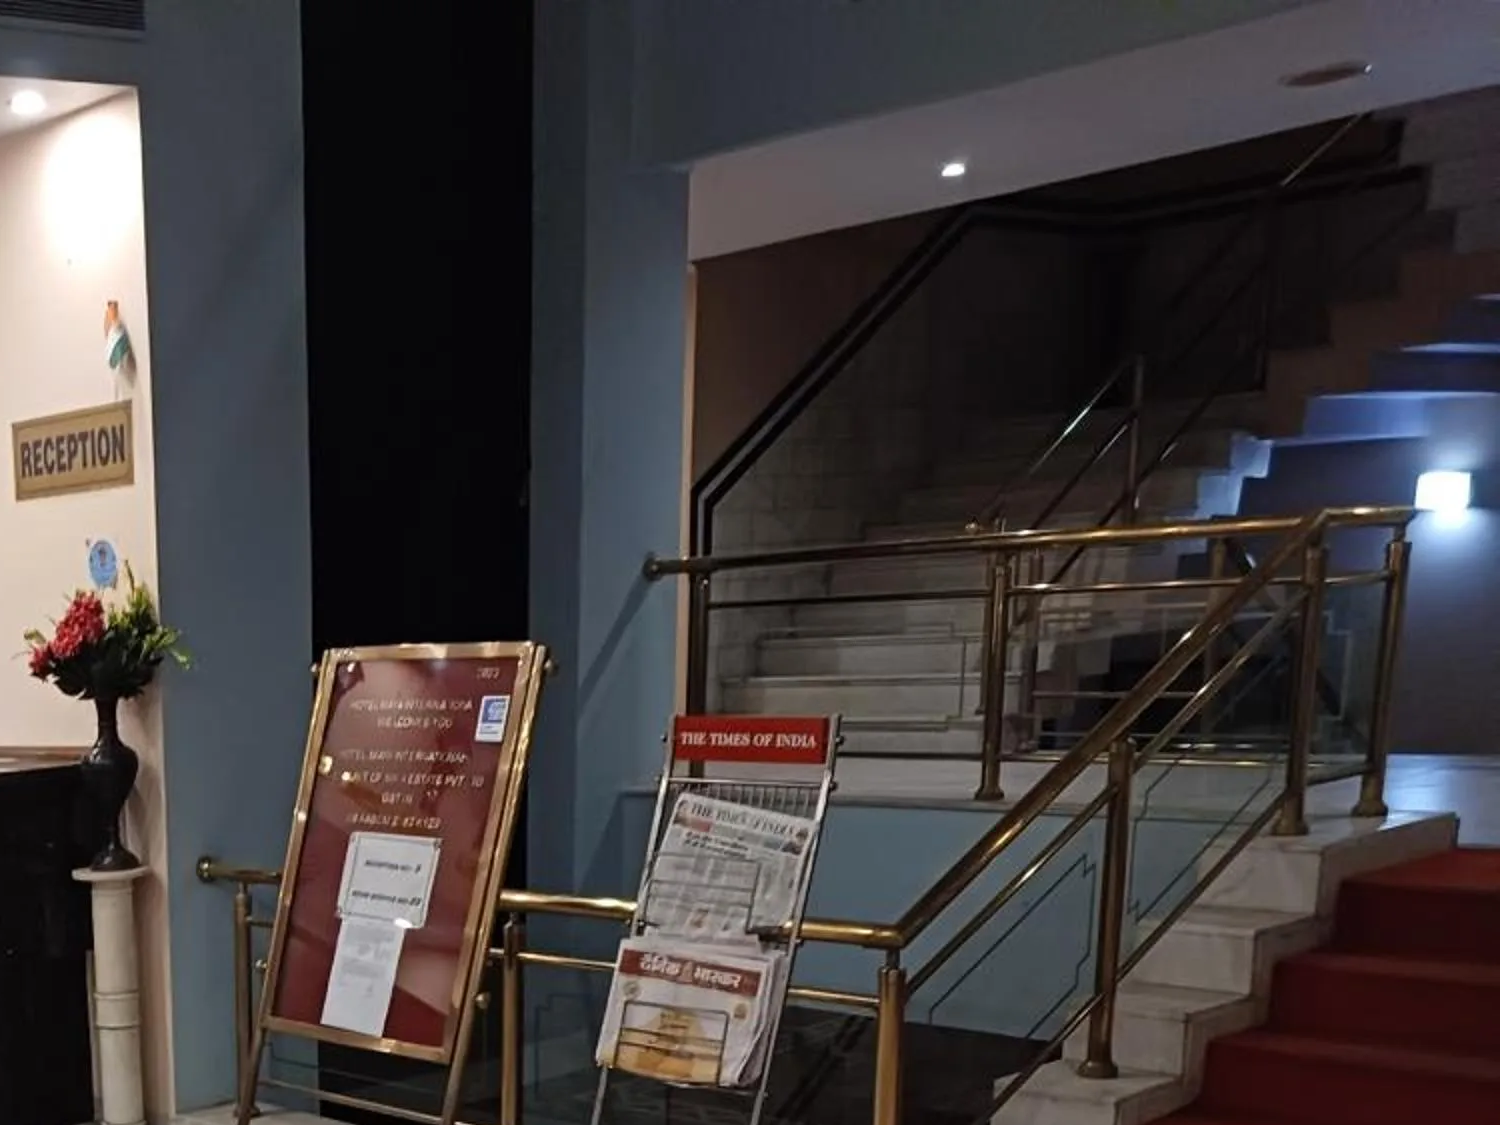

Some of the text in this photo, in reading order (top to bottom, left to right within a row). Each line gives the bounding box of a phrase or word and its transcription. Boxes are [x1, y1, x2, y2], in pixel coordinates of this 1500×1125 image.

[19, 423, 125, 479] RECEPTION
[681, 732, 817, 749] THE TIMES OF INDIA
[692, 965, 742, 989] भास्कर
